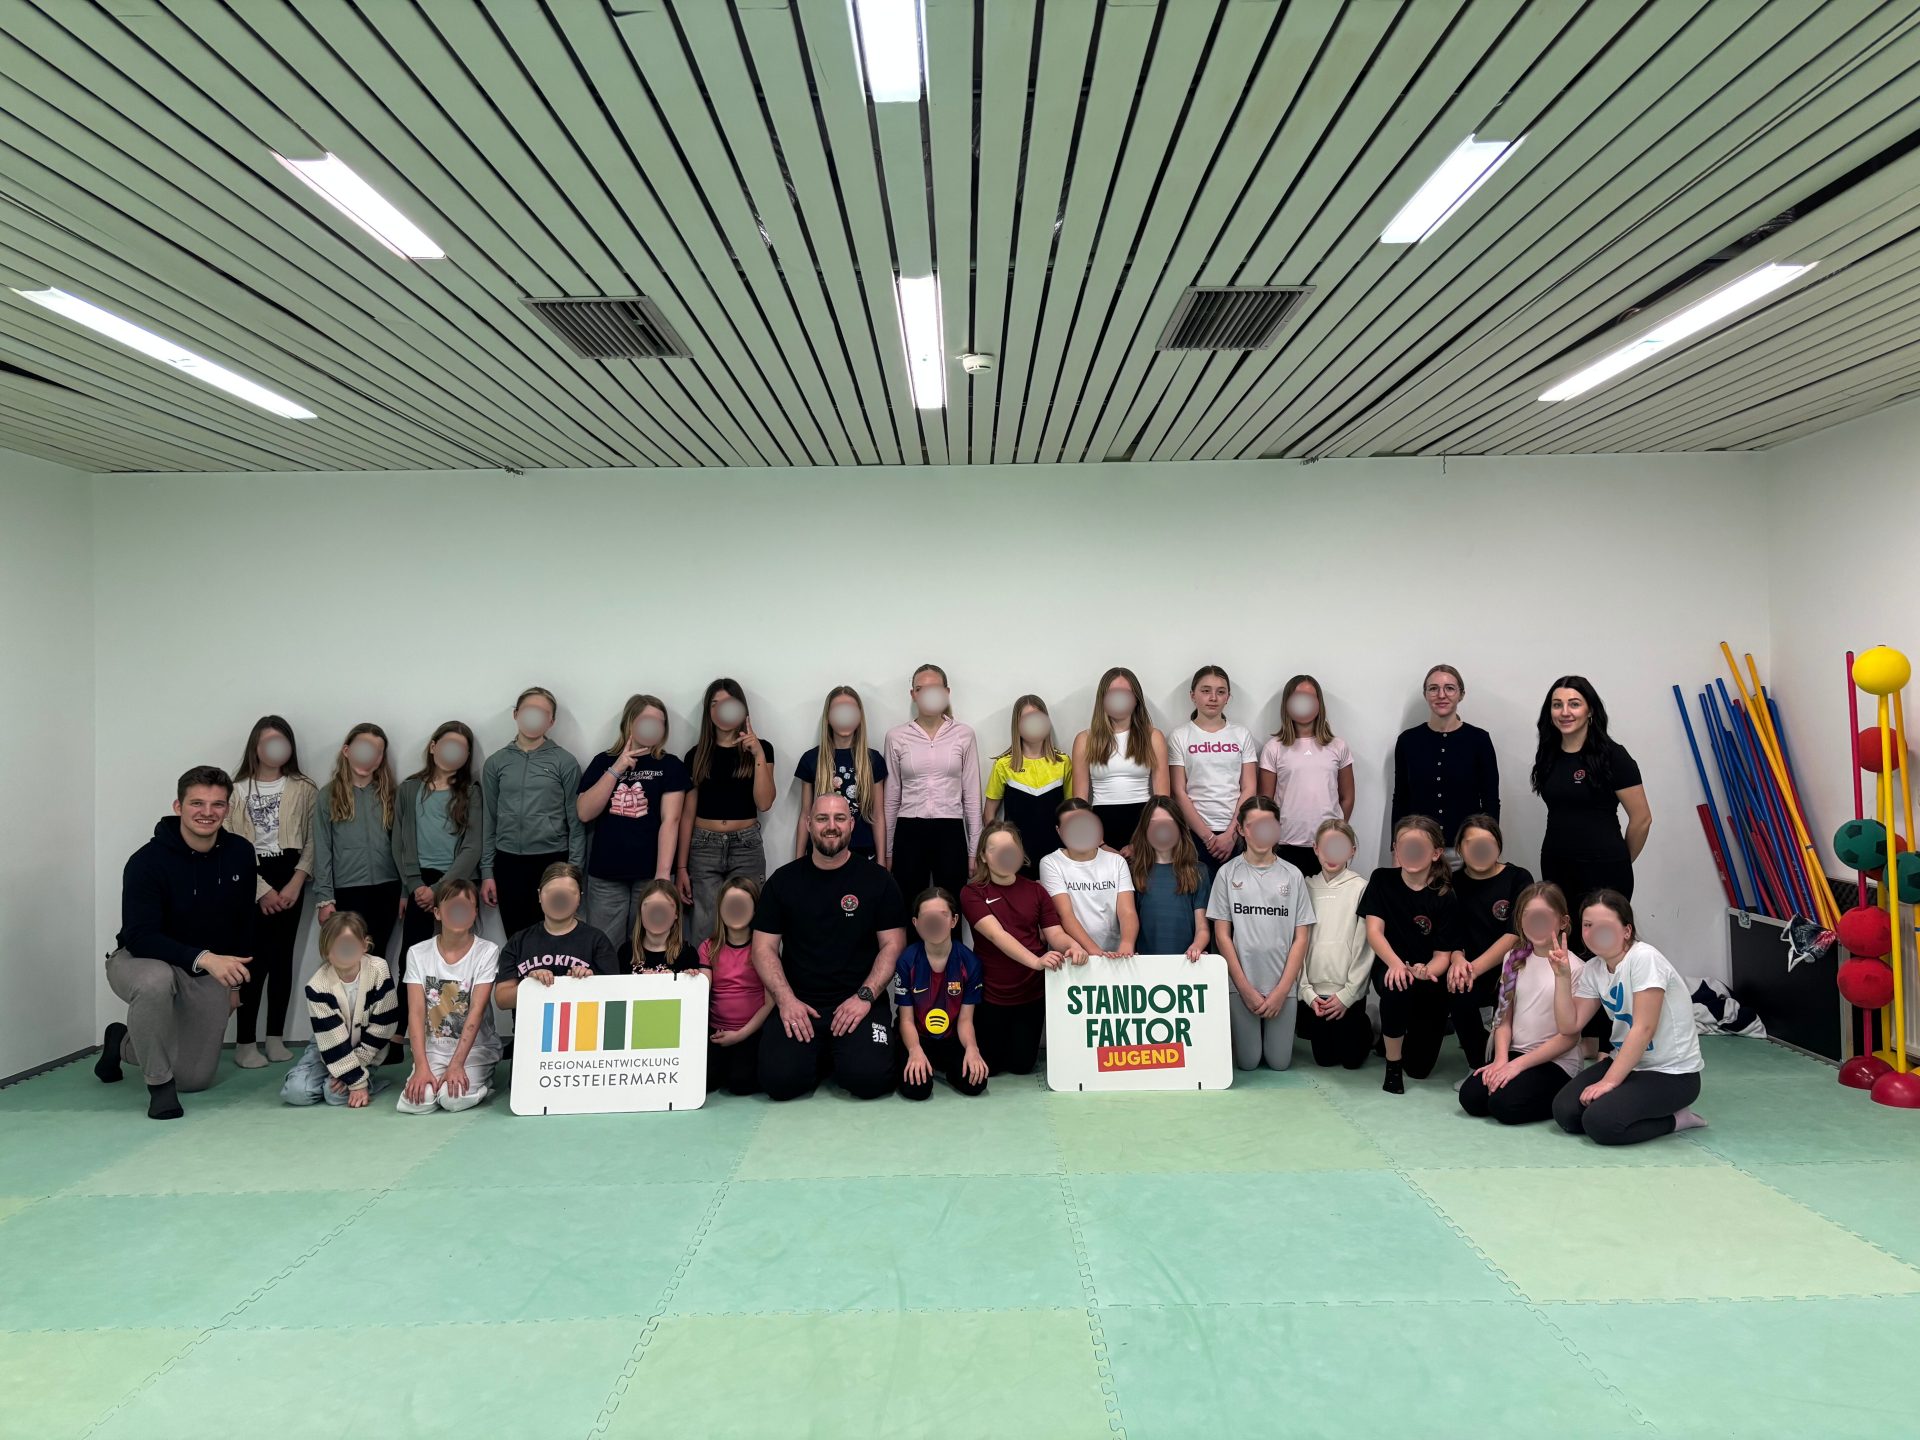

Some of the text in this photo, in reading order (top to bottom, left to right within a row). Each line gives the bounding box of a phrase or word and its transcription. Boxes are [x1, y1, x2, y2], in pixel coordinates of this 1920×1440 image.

[1188, 741, 1240, 753] adidas
[1092, 880, 1116, 891] KLEIN
[1233, 903, 1289, 917] Barmenia
[555, 954, 590, 969] KITT
[1067, 984, 1208, 1015] STANDORT
[1086, 1018, 1193, 1048] FAKTOR
[539, 1057, 680, 1071] REGIONALENTWICKLUNG
[1103, 1048, 1180, 1068] JUGEND
[539, 1071, 679, 1088] OSTSTEIERMARK
